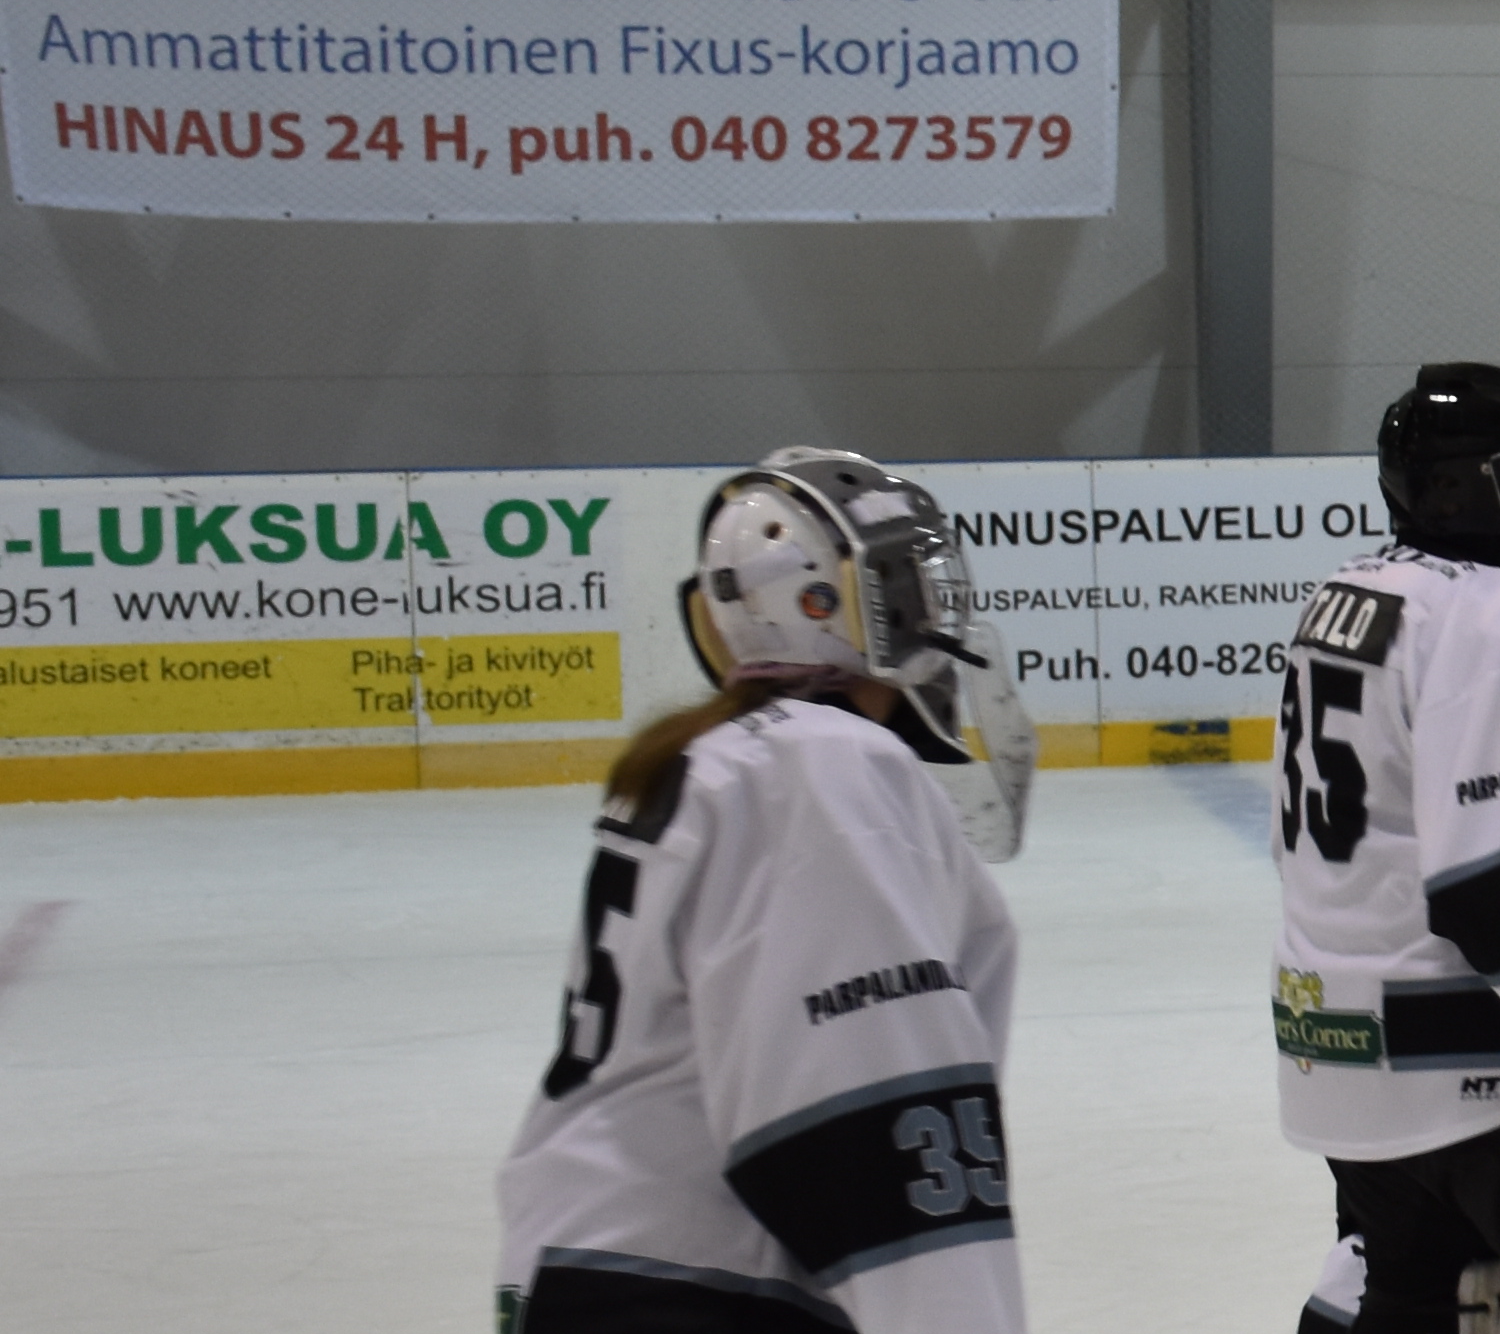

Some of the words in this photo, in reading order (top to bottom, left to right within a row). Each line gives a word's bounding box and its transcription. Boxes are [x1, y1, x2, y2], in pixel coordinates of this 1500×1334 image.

[37, 15, 599, 75] Ammattitaitoinen
[621, 23, 1079, 88] Fixus-korjaamo
[53, 101, 306, 161] HINAUS
[324, 113, 402, 161] 24
[422, 114, 490, 171] H,
[508, 113, 655, 175] puh.
[670, 113, 788, 161] 040
[805, 114, 1072, 163] 8273579
[482, 497, 611, 560] OY
[953, 504, 1304, 547] NNUSPALVELU
[1160, 582, 1321, 607] RAKENNUS
[160, 655, 273, 682] koneet
[351, 648, 436, 676] Piha-
[445, 647, 474, 679] ja
[486, 646, 595, 677] kivityöt
[1017, 649, 1111, 683] Puh.
[1128, 643, 1287, 678] 040-826
[1281, 660, 1369, 865] 35
[1301, 1017, 1373, 1051] Corner
[892, 1096, 1008, 1218] 35
